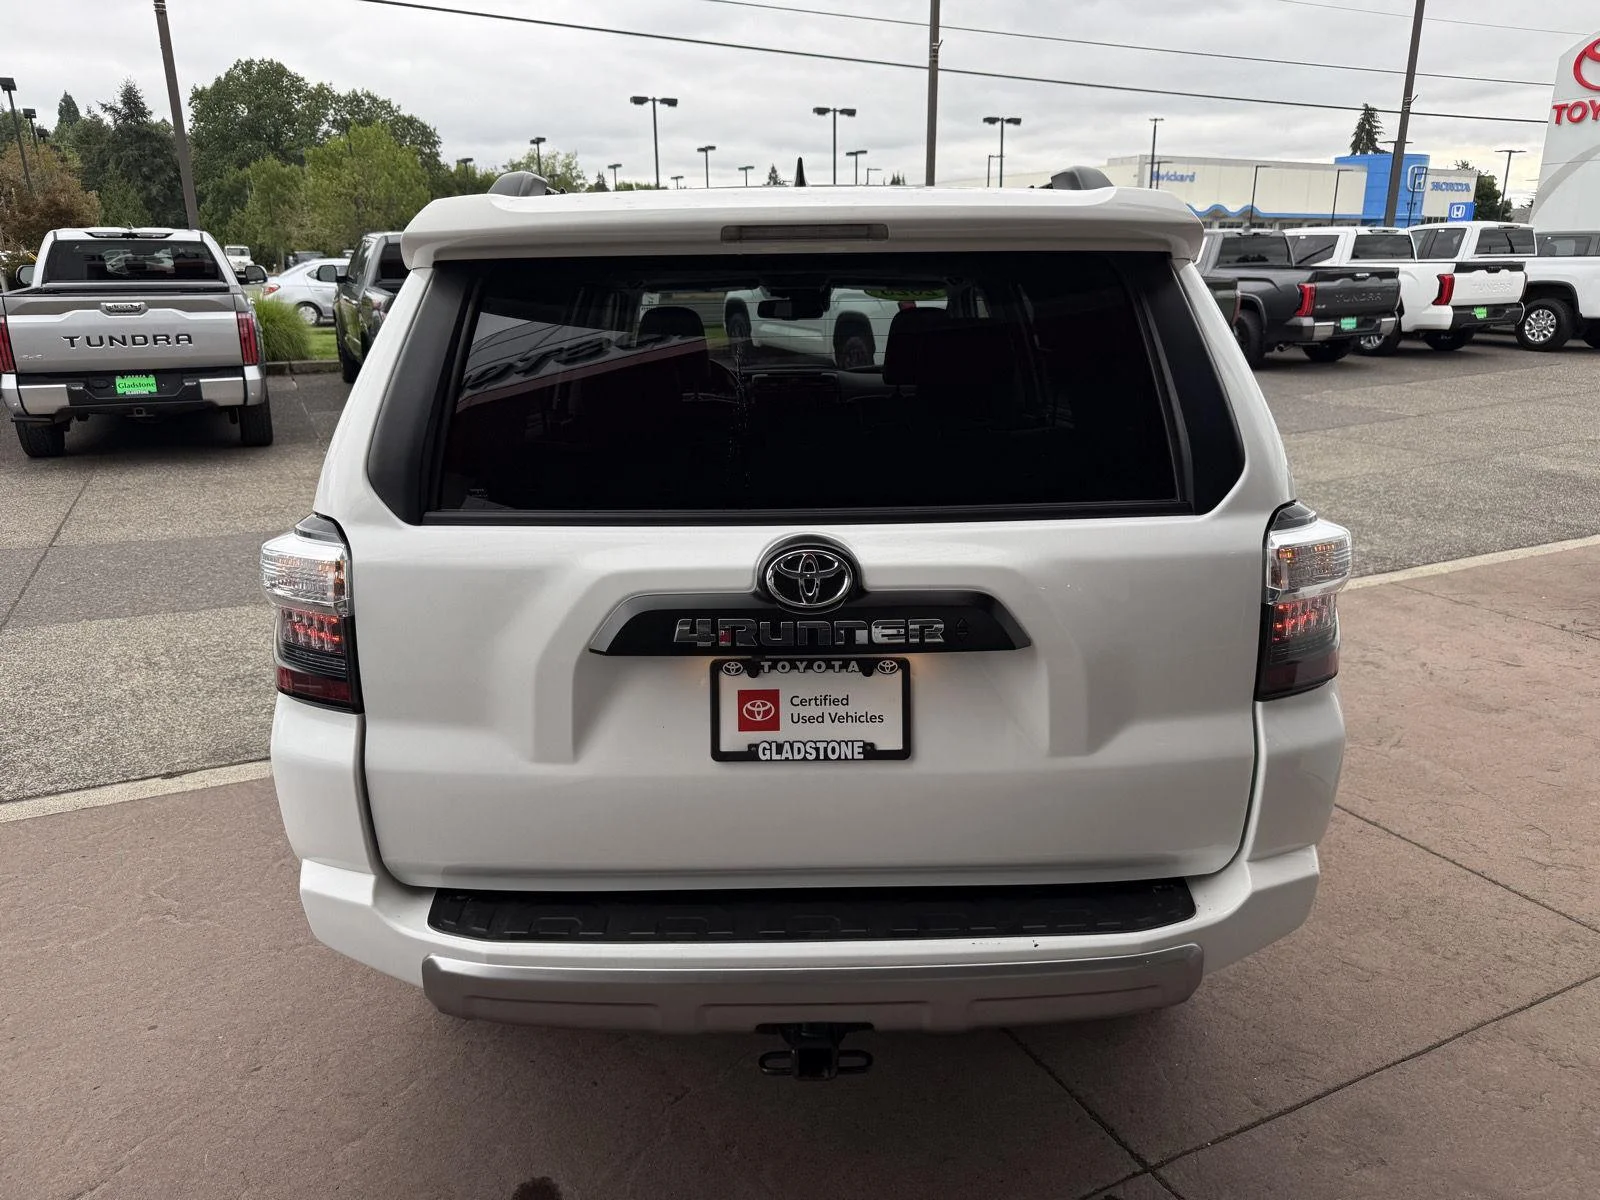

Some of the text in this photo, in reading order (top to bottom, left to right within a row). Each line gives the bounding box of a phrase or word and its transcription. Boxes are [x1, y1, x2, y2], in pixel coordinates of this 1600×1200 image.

[1431, 181, 1471, 192] HONDA
[61, 333, 194, 349] TUNDRA
[673, 618, 946, 647] 4RUNNER
[760, 661, 861, 673] TOYOTA
[790, 694, 849, 707] Certified
[790, 711, 884, 724] Used Vehicles
[757, 740, 865, 761] GLADSTONE
